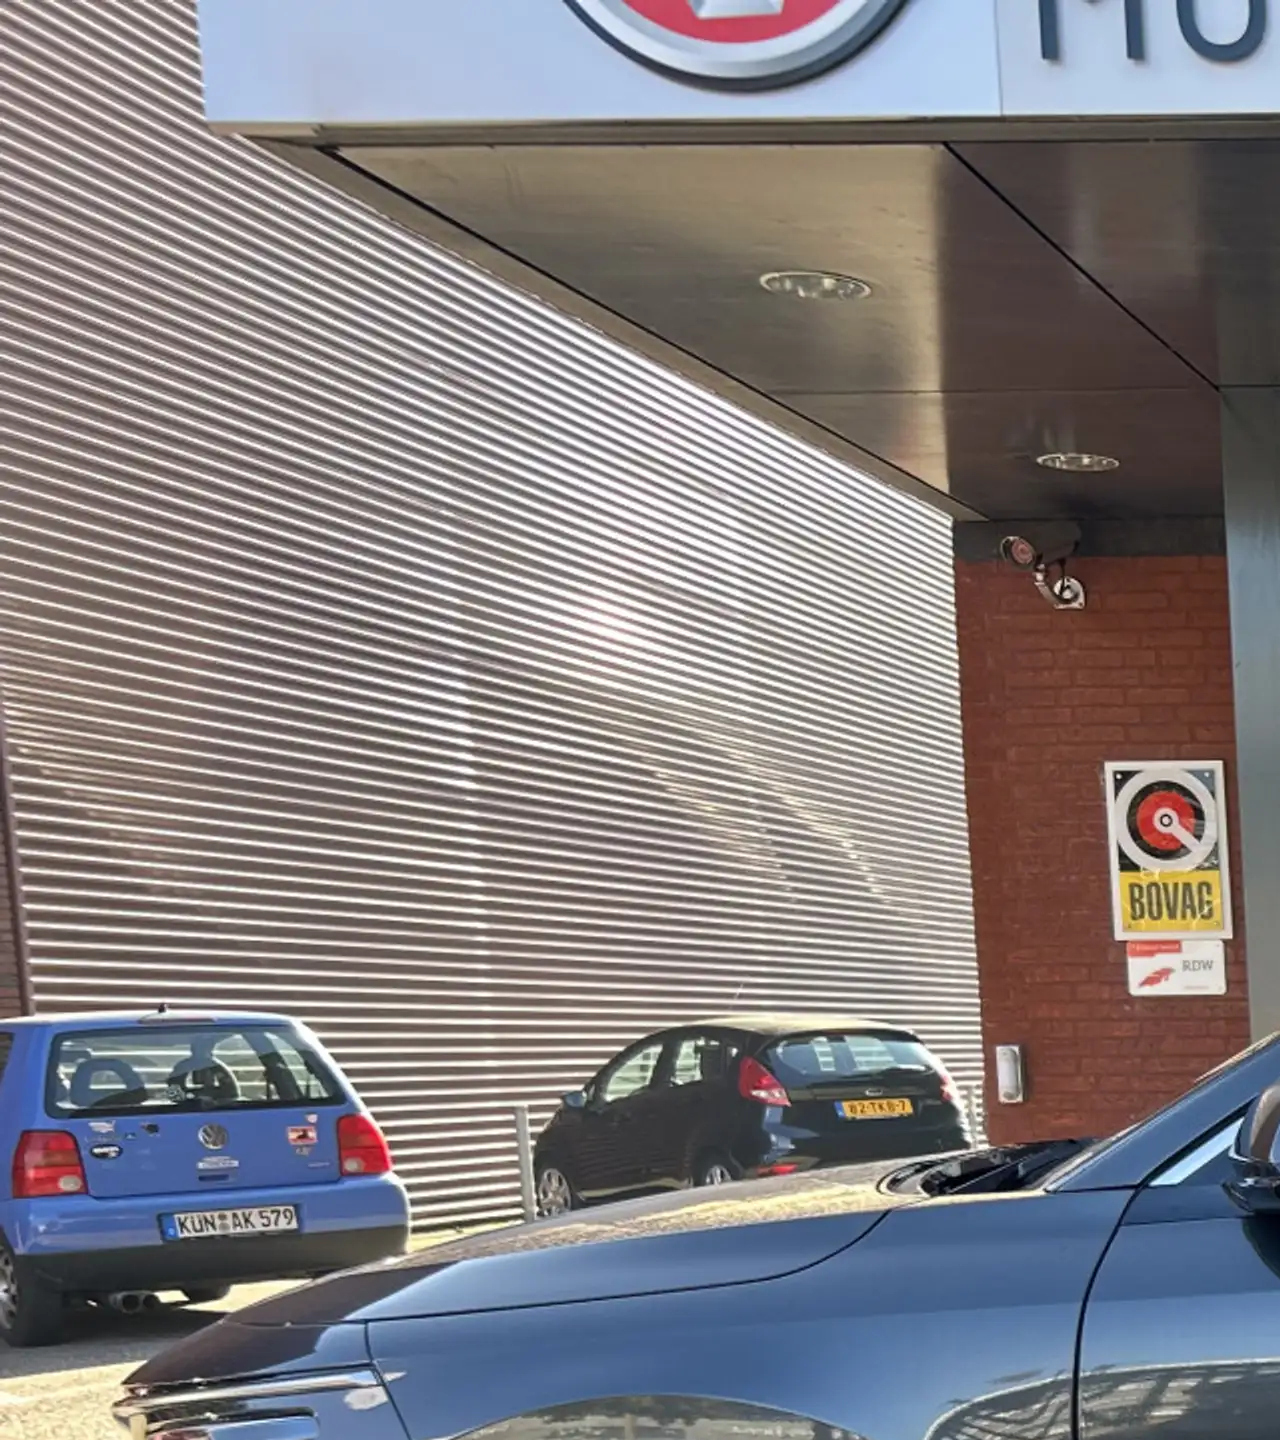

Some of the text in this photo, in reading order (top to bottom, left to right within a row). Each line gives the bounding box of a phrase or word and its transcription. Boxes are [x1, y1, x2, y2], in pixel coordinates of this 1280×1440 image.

[1182, 960, 1213, 972] RDW
[232, 1211, 255, 1231] AK
[261, 1208, 294, 1228] 579
